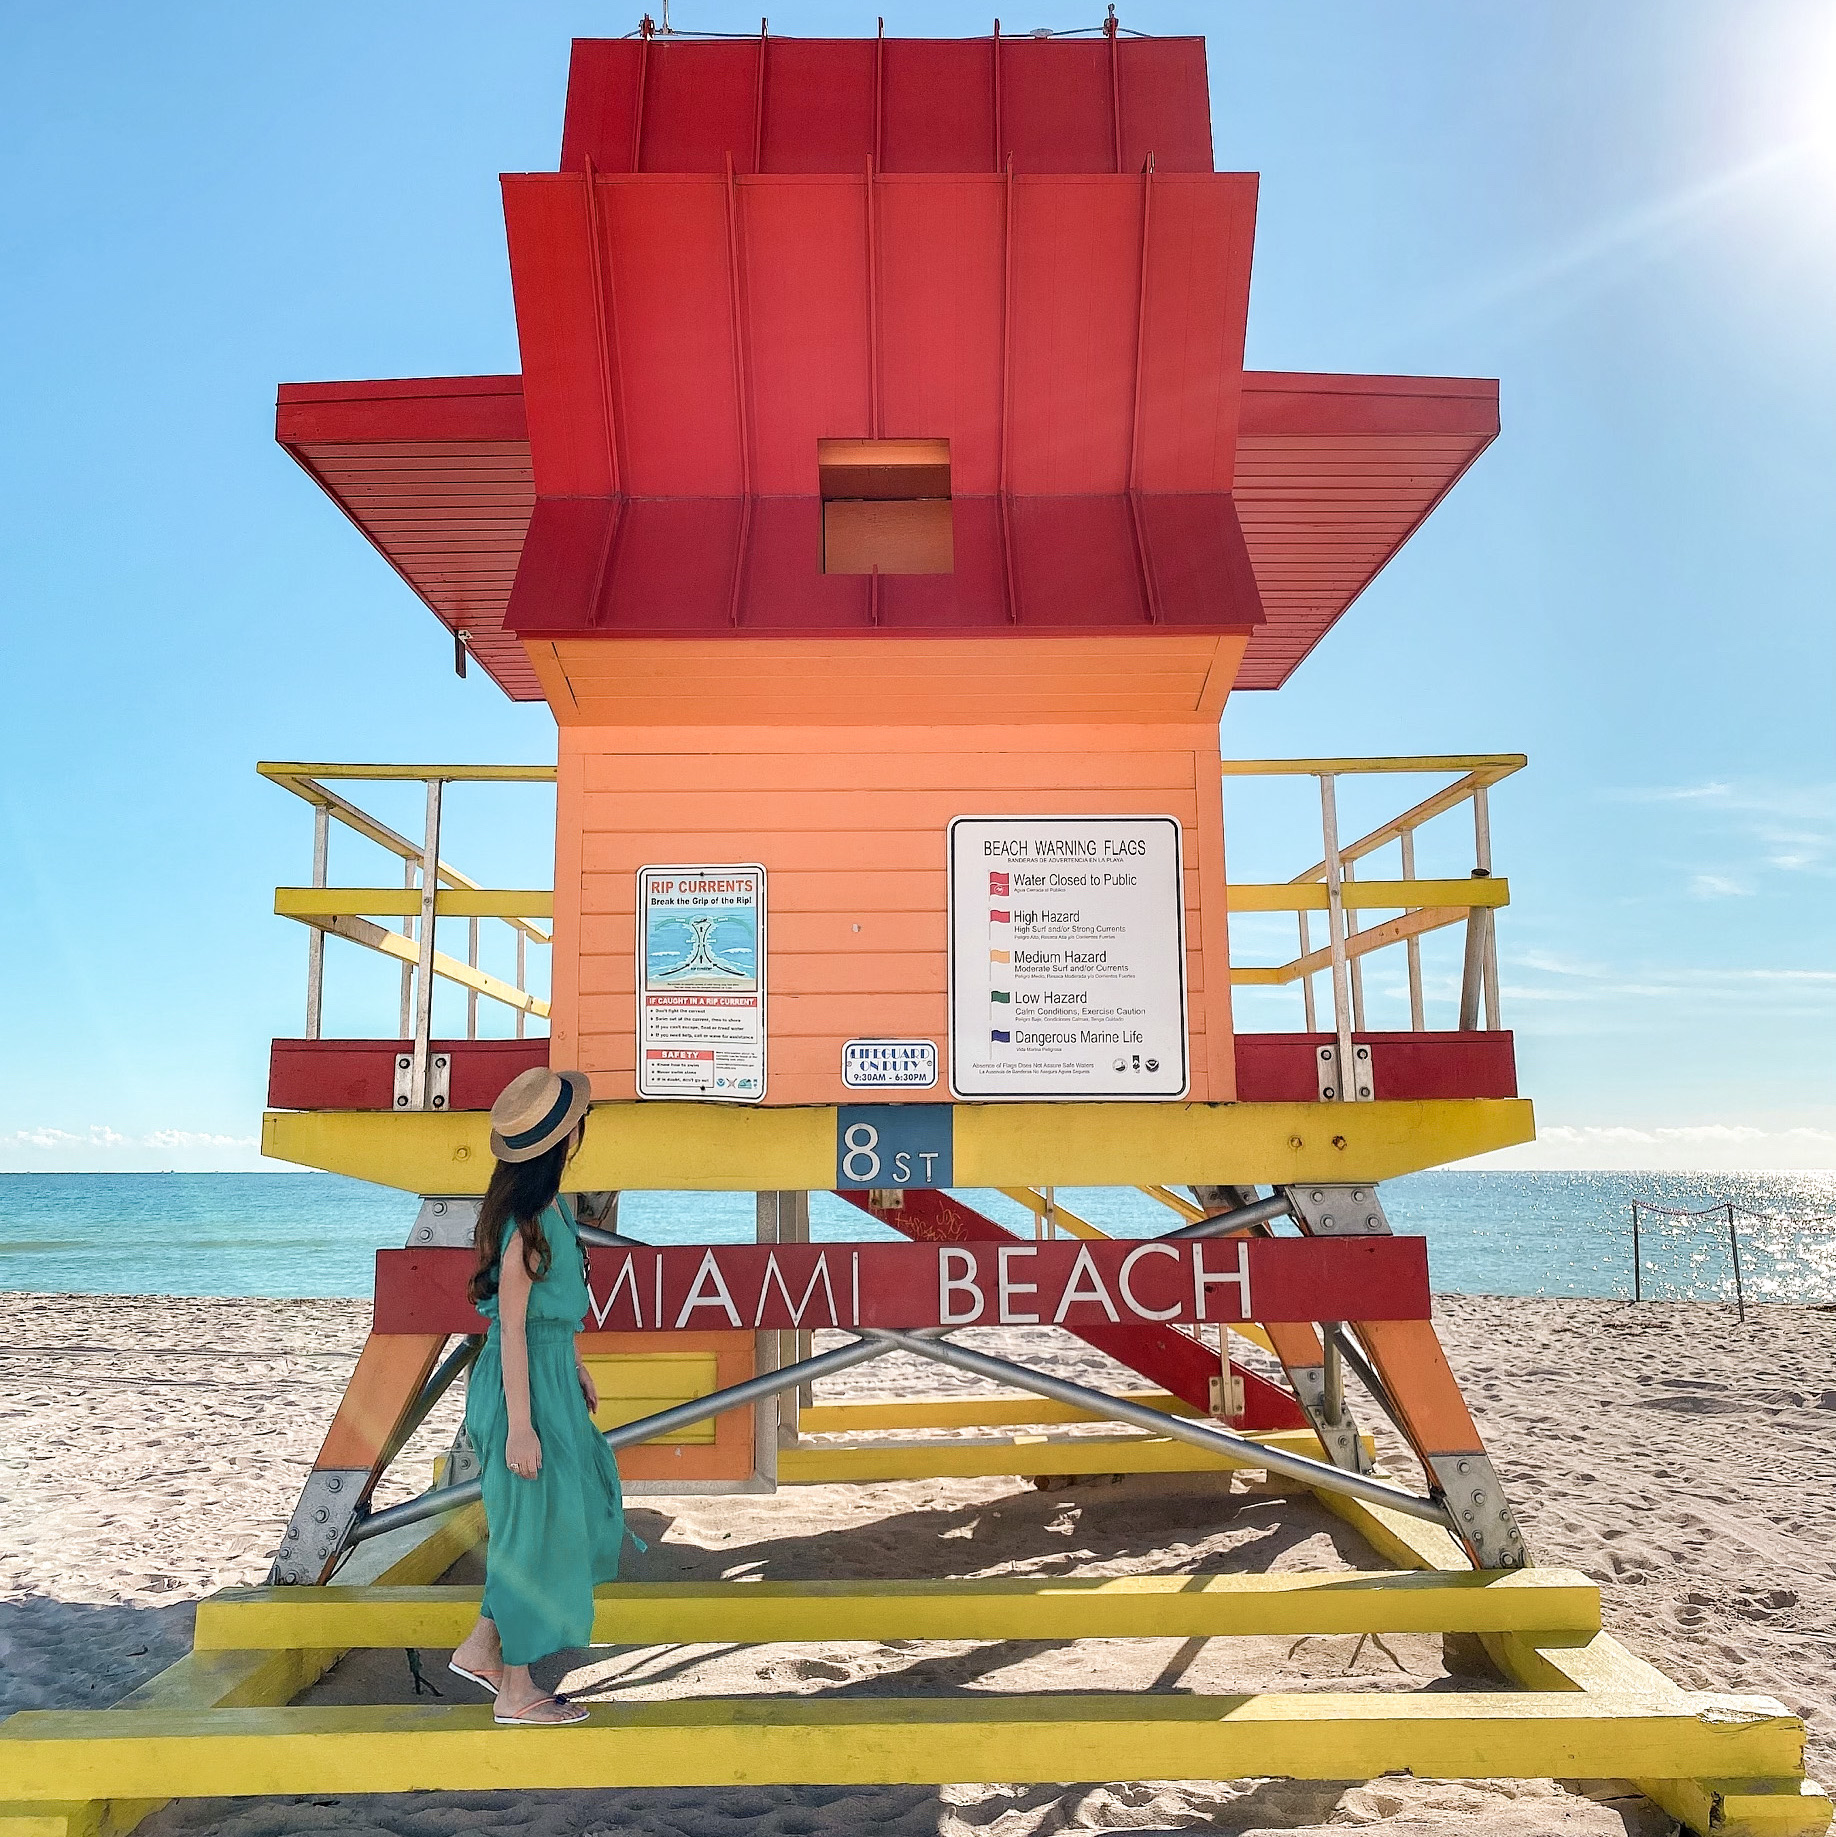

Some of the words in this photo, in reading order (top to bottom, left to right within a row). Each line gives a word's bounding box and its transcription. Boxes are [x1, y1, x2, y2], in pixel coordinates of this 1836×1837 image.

[984, 840, 1028, 856] BEACH
[1035, 840, 1096, 856] WARNING
[1104, 840, 1146, 856] FLAGS
[1014, 874, 1046, 886] Water
[1049, 874, 1086, 886] Closed
[1090, 874, 1100, 886] to
[1104, 874, 1137, 886] Public
[652, 881, 674, 894] RIP
[679, 880, 753, 893] CURRENTS
[692, 897, 708, 906] Grip
[737, 896, 752, 905] Rip!
[1014, 910, 1038, 925] High
[1042, 910, 1080, 922] Hazard
[1014, 926, 1030, 934] High
[1072, 926, 1094, 934] Strong
[1015, 950, 1060, 963] Medium
[1065, 950, 1106, 963] Hazard
[1015, 991, 1040, 1004] Low
[1044, 991, 1087, 1004] Hazard
[1037, 1008, 1080, 1016] Conditions,
[1016, 1031, 1076, 1046] Dangerous
[1080, 1031, 1119, 1043] Marine
[1123, 1031, 1143, 1043] Life
[850, 1049, 929, 1059] LIFEGUARD
[860, 1061, 879, 1071] ON
[882, 1061, 920, 1071] DUTY
[842, 1123, 880, 1181] 8
[892, 1152, 939, 1182] ST
[587, 1246, 859, 1329] MIAMI
[939, 1242, 1252, 1325] BEACH
